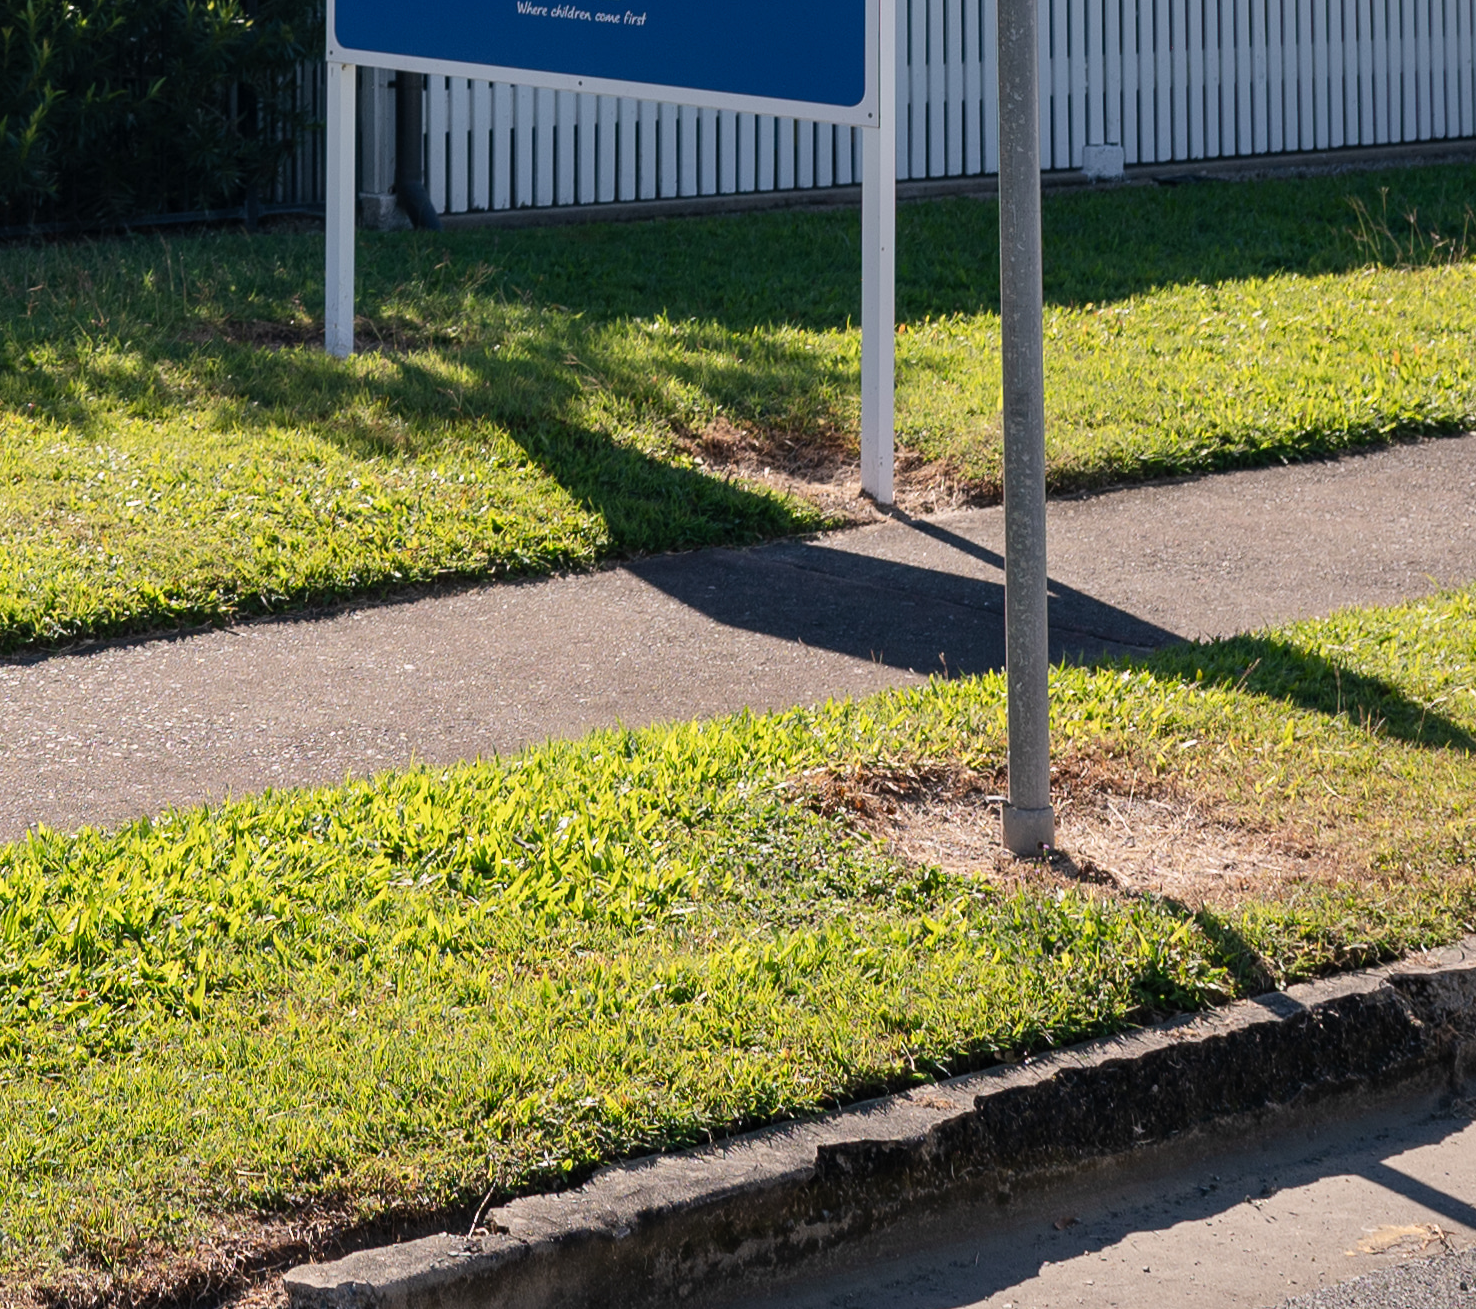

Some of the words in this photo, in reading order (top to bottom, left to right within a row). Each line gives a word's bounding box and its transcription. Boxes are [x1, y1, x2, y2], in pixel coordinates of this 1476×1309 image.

[517, 1, 547, 16] Where
[551, 5, 591, 21] children
[595, 13, 620, 23] come
[624, 11, 646, 25] first
